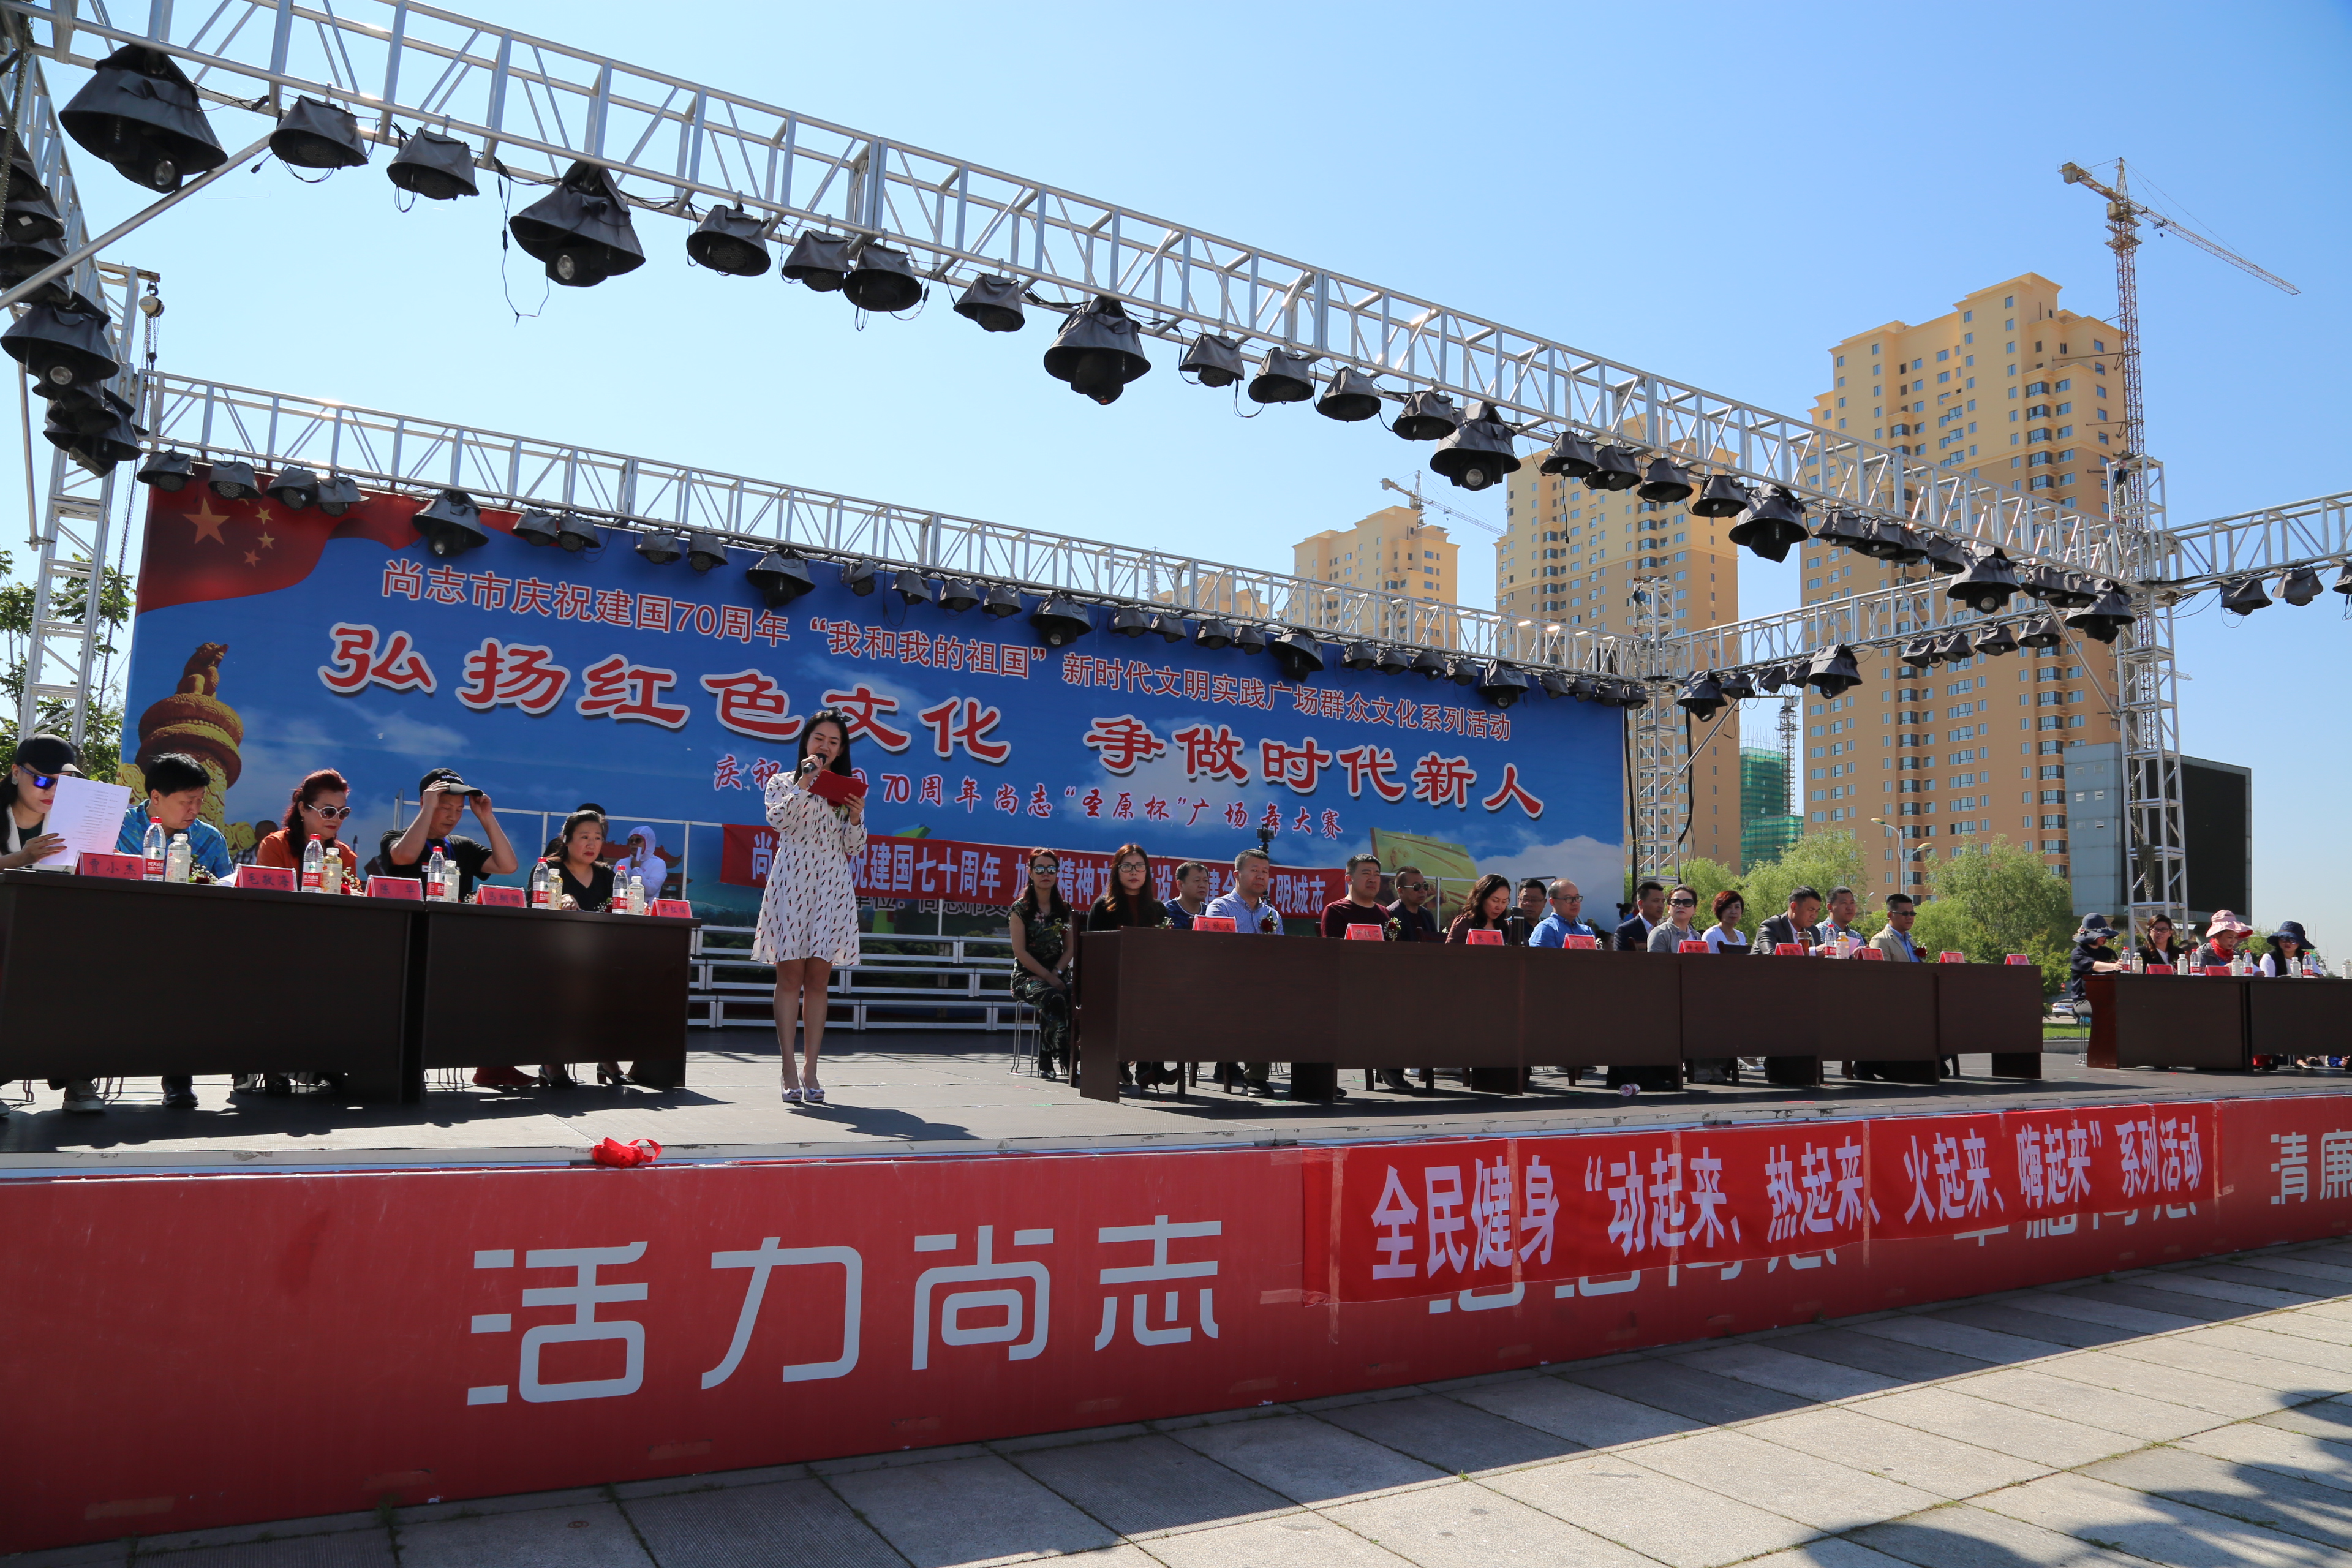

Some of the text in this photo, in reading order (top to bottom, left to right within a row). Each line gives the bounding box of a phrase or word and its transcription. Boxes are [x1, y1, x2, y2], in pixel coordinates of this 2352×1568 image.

[318, 622, 1545, 818] 弘扬红色文化 争做时代新人
[751, 831, 1001, 899] 尚祝建国七十周年
[467, 1214, 1223, 1407] 活力尚志
